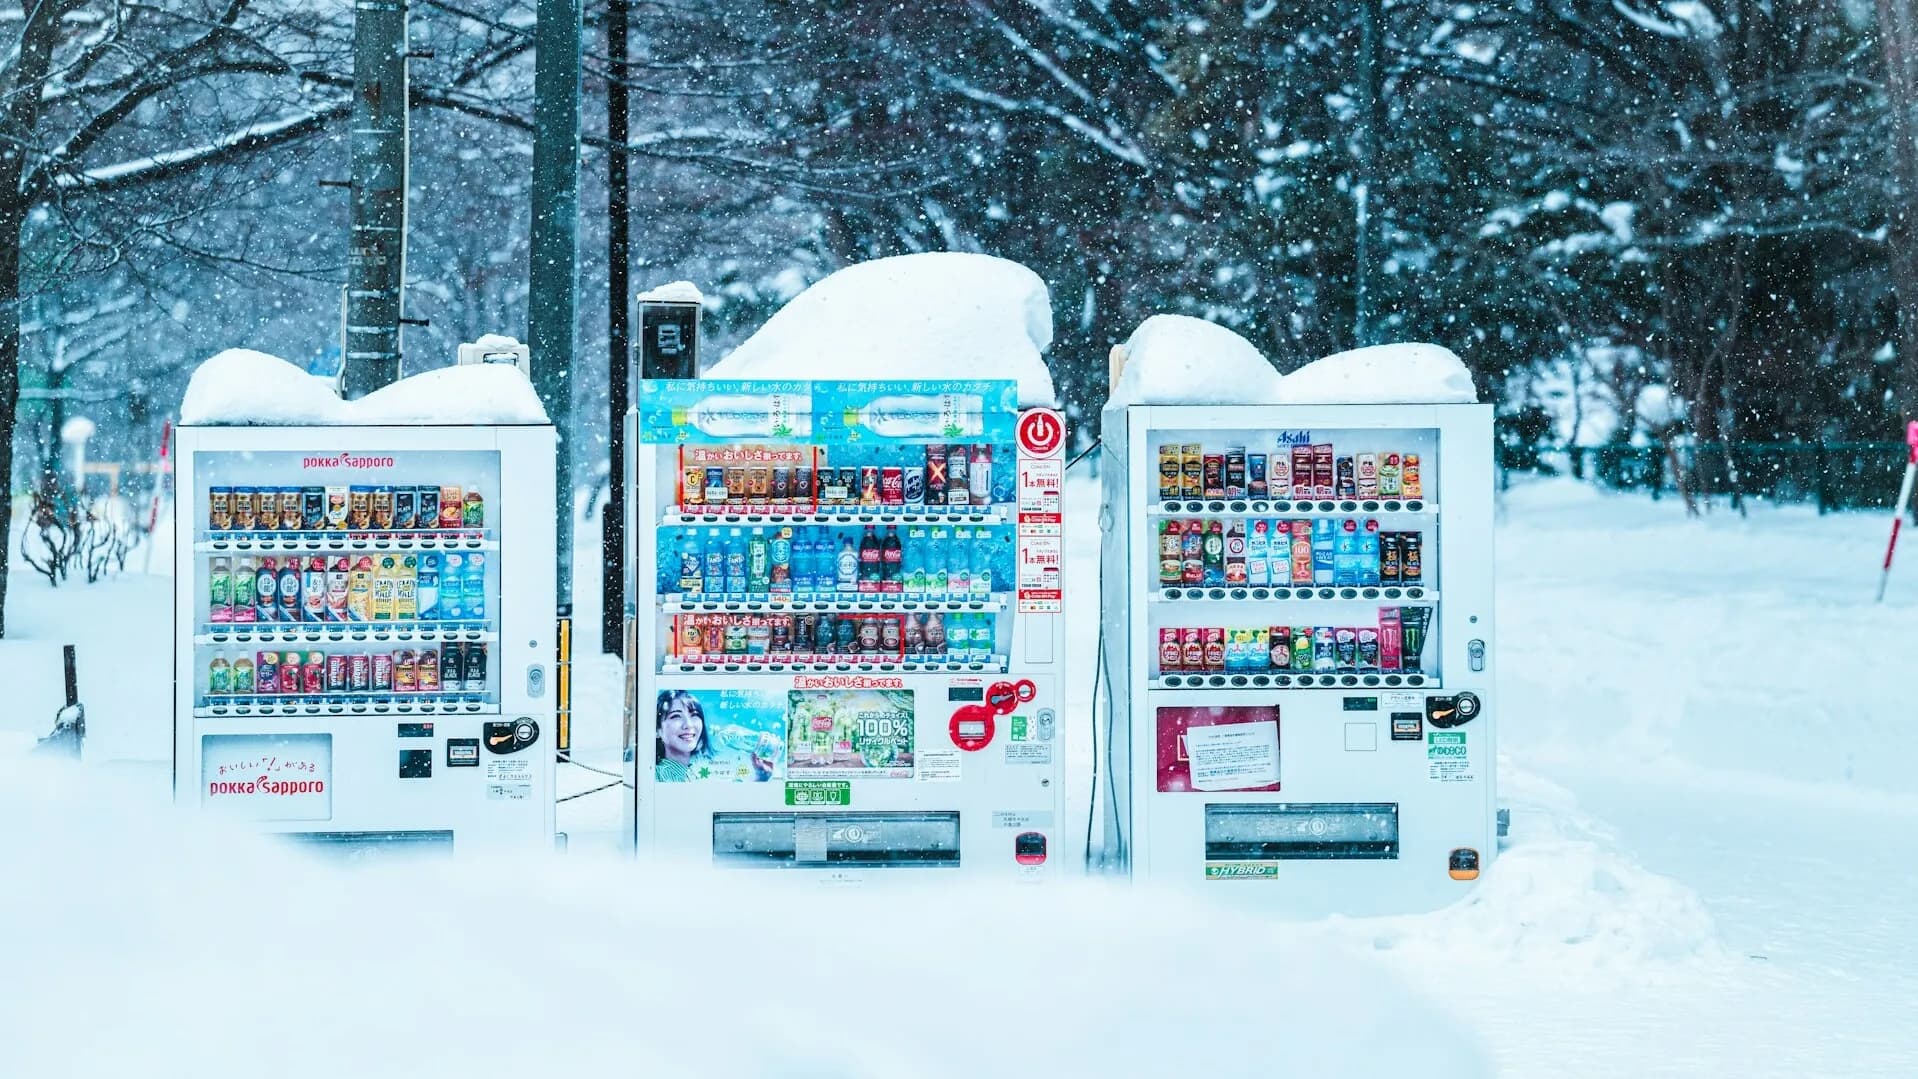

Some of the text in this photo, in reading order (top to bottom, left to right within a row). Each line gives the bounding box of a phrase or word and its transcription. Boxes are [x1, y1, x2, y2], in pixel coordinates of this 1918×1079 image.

[1277, 430, 1310, 444] Asahi
[856, 719, 909, 737] 100%
[858, 737, 909, 745] リサイクルペット
[262, 780, 324, 795] sapporo
[1219, 866, 1266, 878] HYBRID
